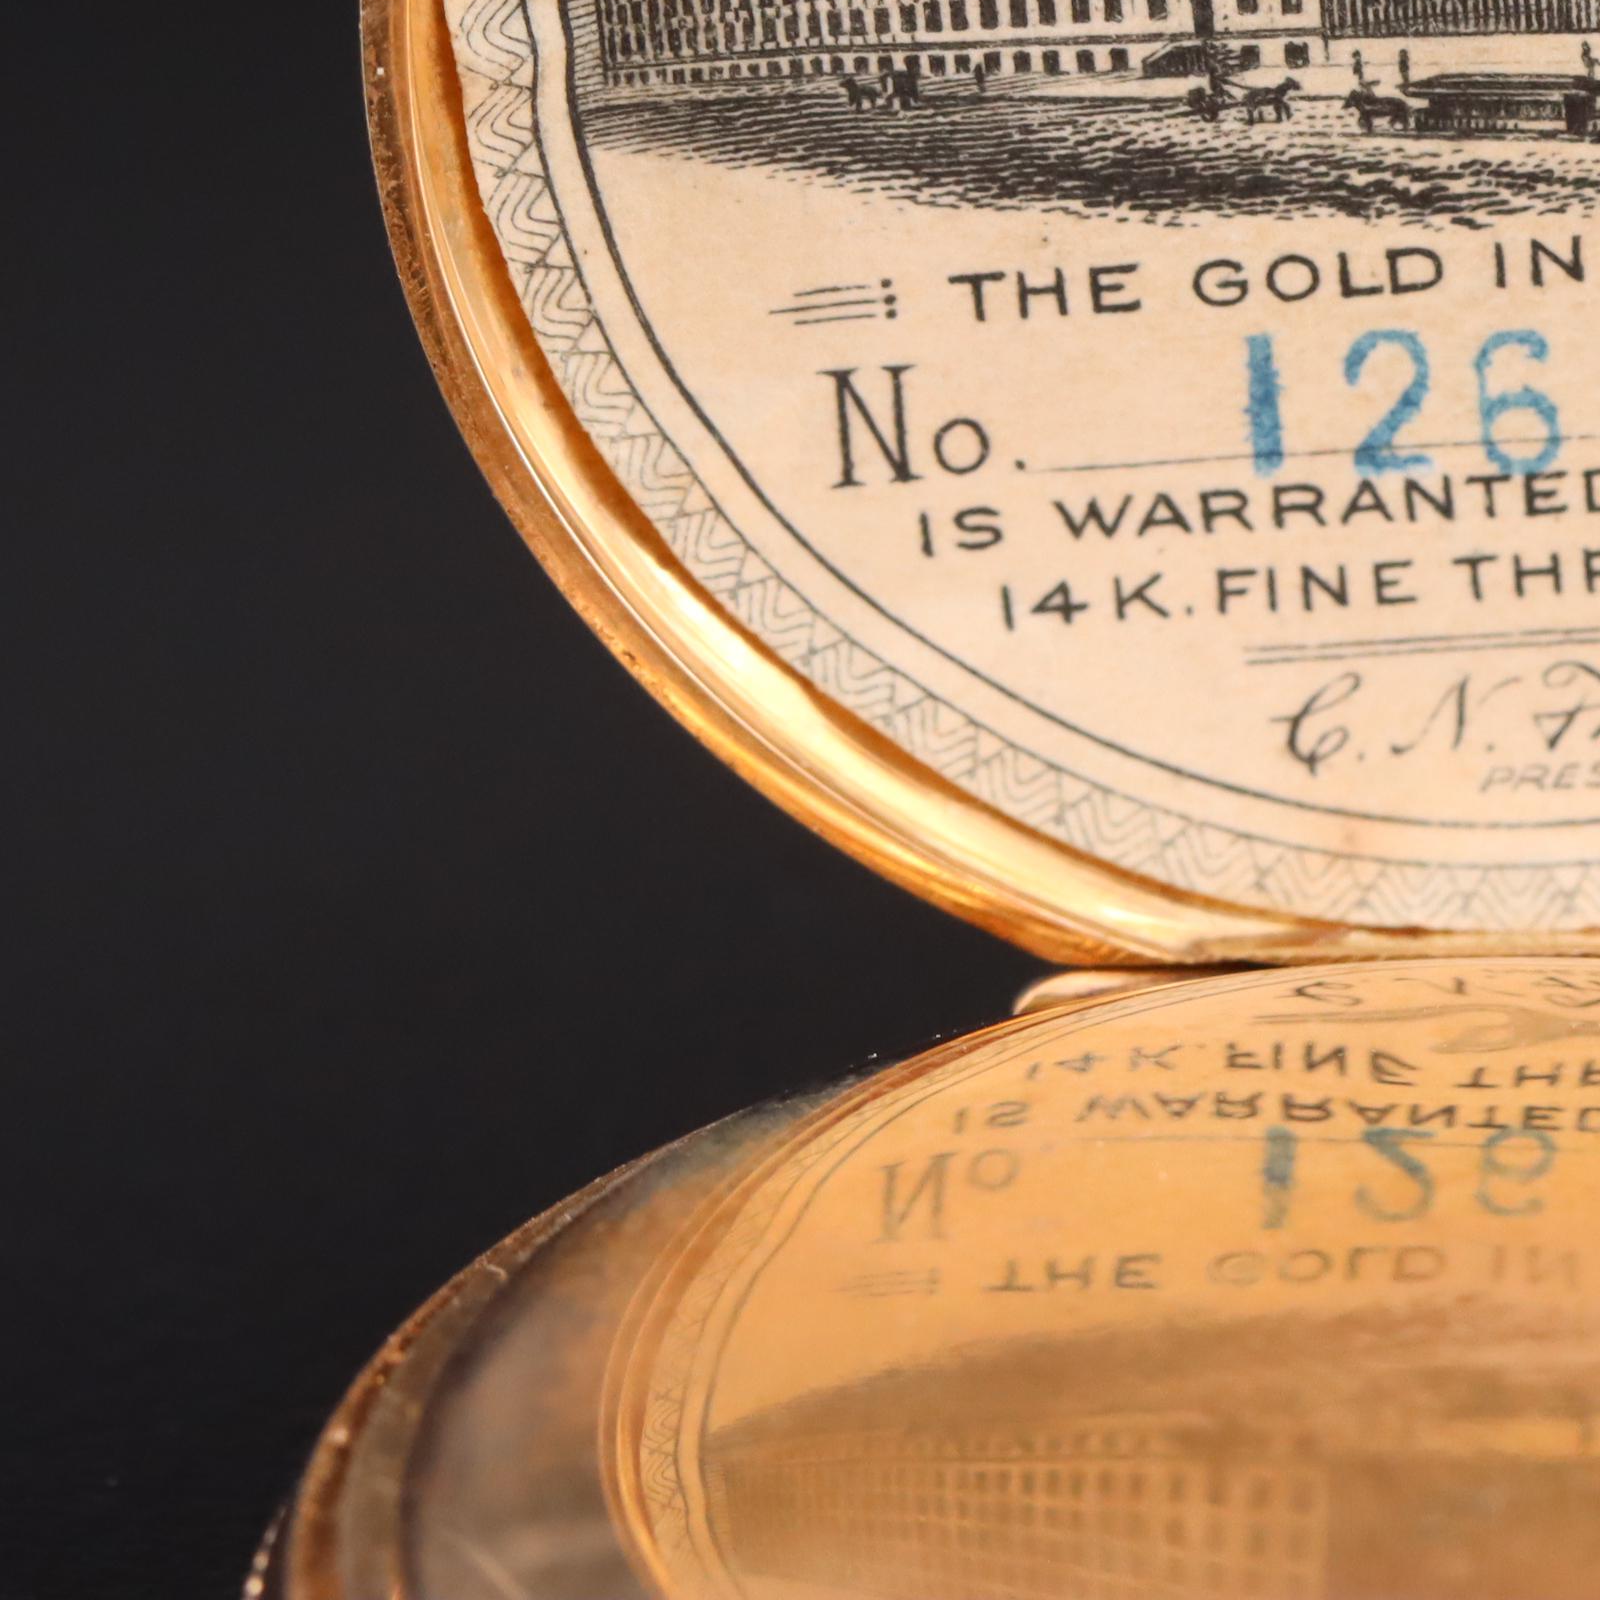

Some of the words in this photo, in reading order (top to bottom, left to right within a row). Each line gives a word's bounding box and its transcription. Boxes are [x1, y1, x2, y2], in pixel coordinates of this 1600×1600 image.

[947, 262, 1143, 322] THE
[1191, 246, 1444, 306] GOLD
[1494, 234, 1585, 289] IN
[816, 363, 1027, 490] No.
[919, 506, 1003, 558] IS
[1217, 561, 1417, 615] FINE
